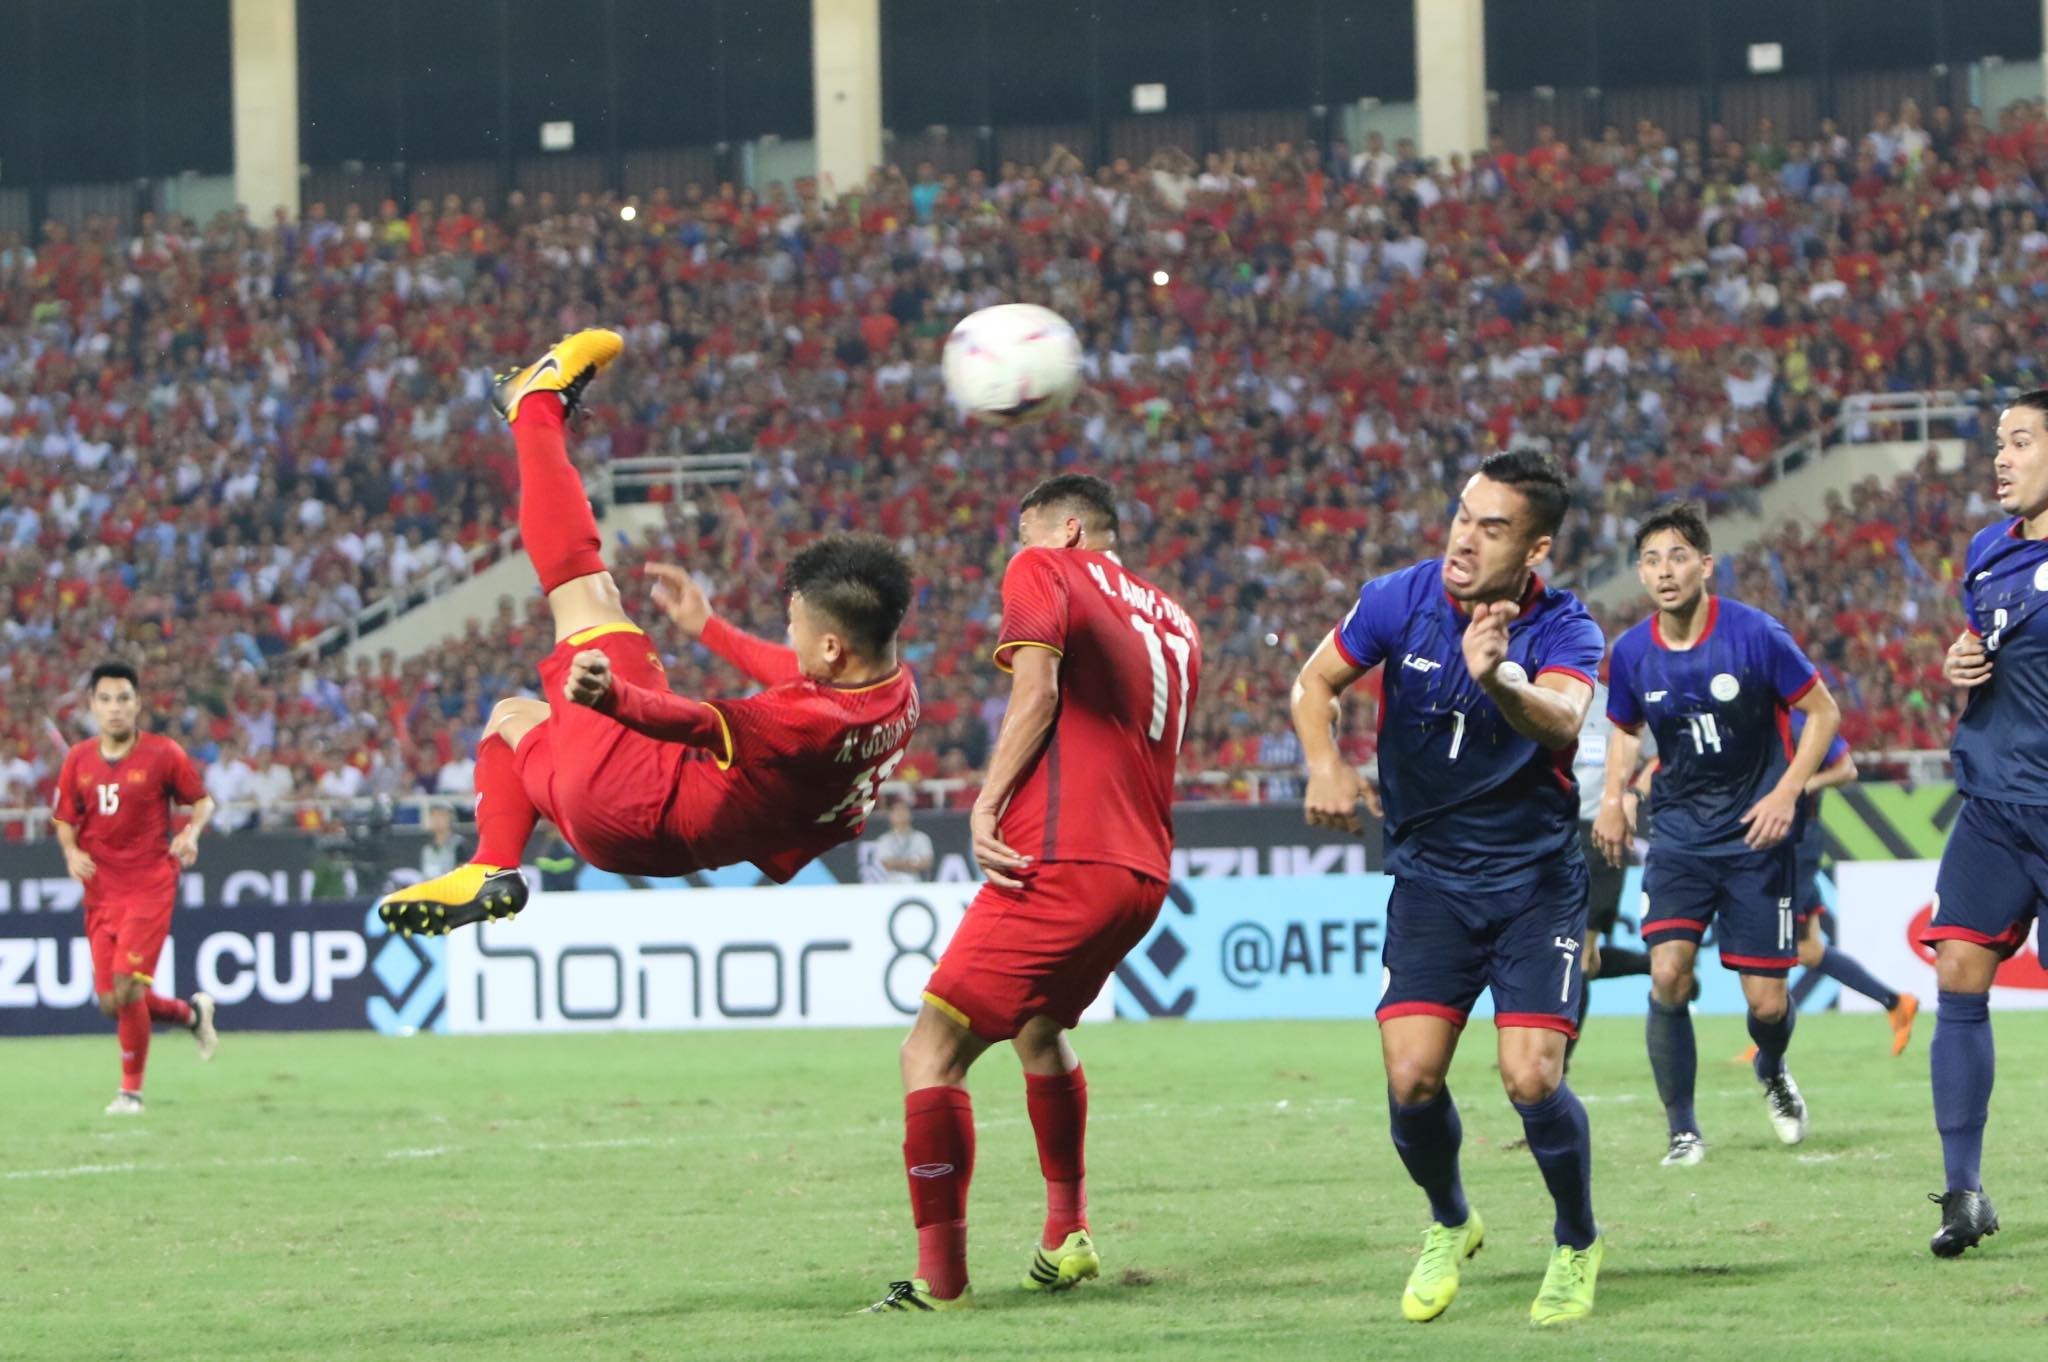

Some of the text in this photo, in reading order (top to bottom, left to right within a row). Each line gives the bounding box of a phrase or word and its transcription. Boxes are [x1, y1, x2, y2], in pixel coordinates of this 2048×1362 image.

[1687, 712, 1721, 755] 14
[97, 783, 120, 816] 15
[196, 930, 367, 1005] CUP
[476, 920, 852, 1021] honor
[1221, 920, 1380, 989] @AFF
